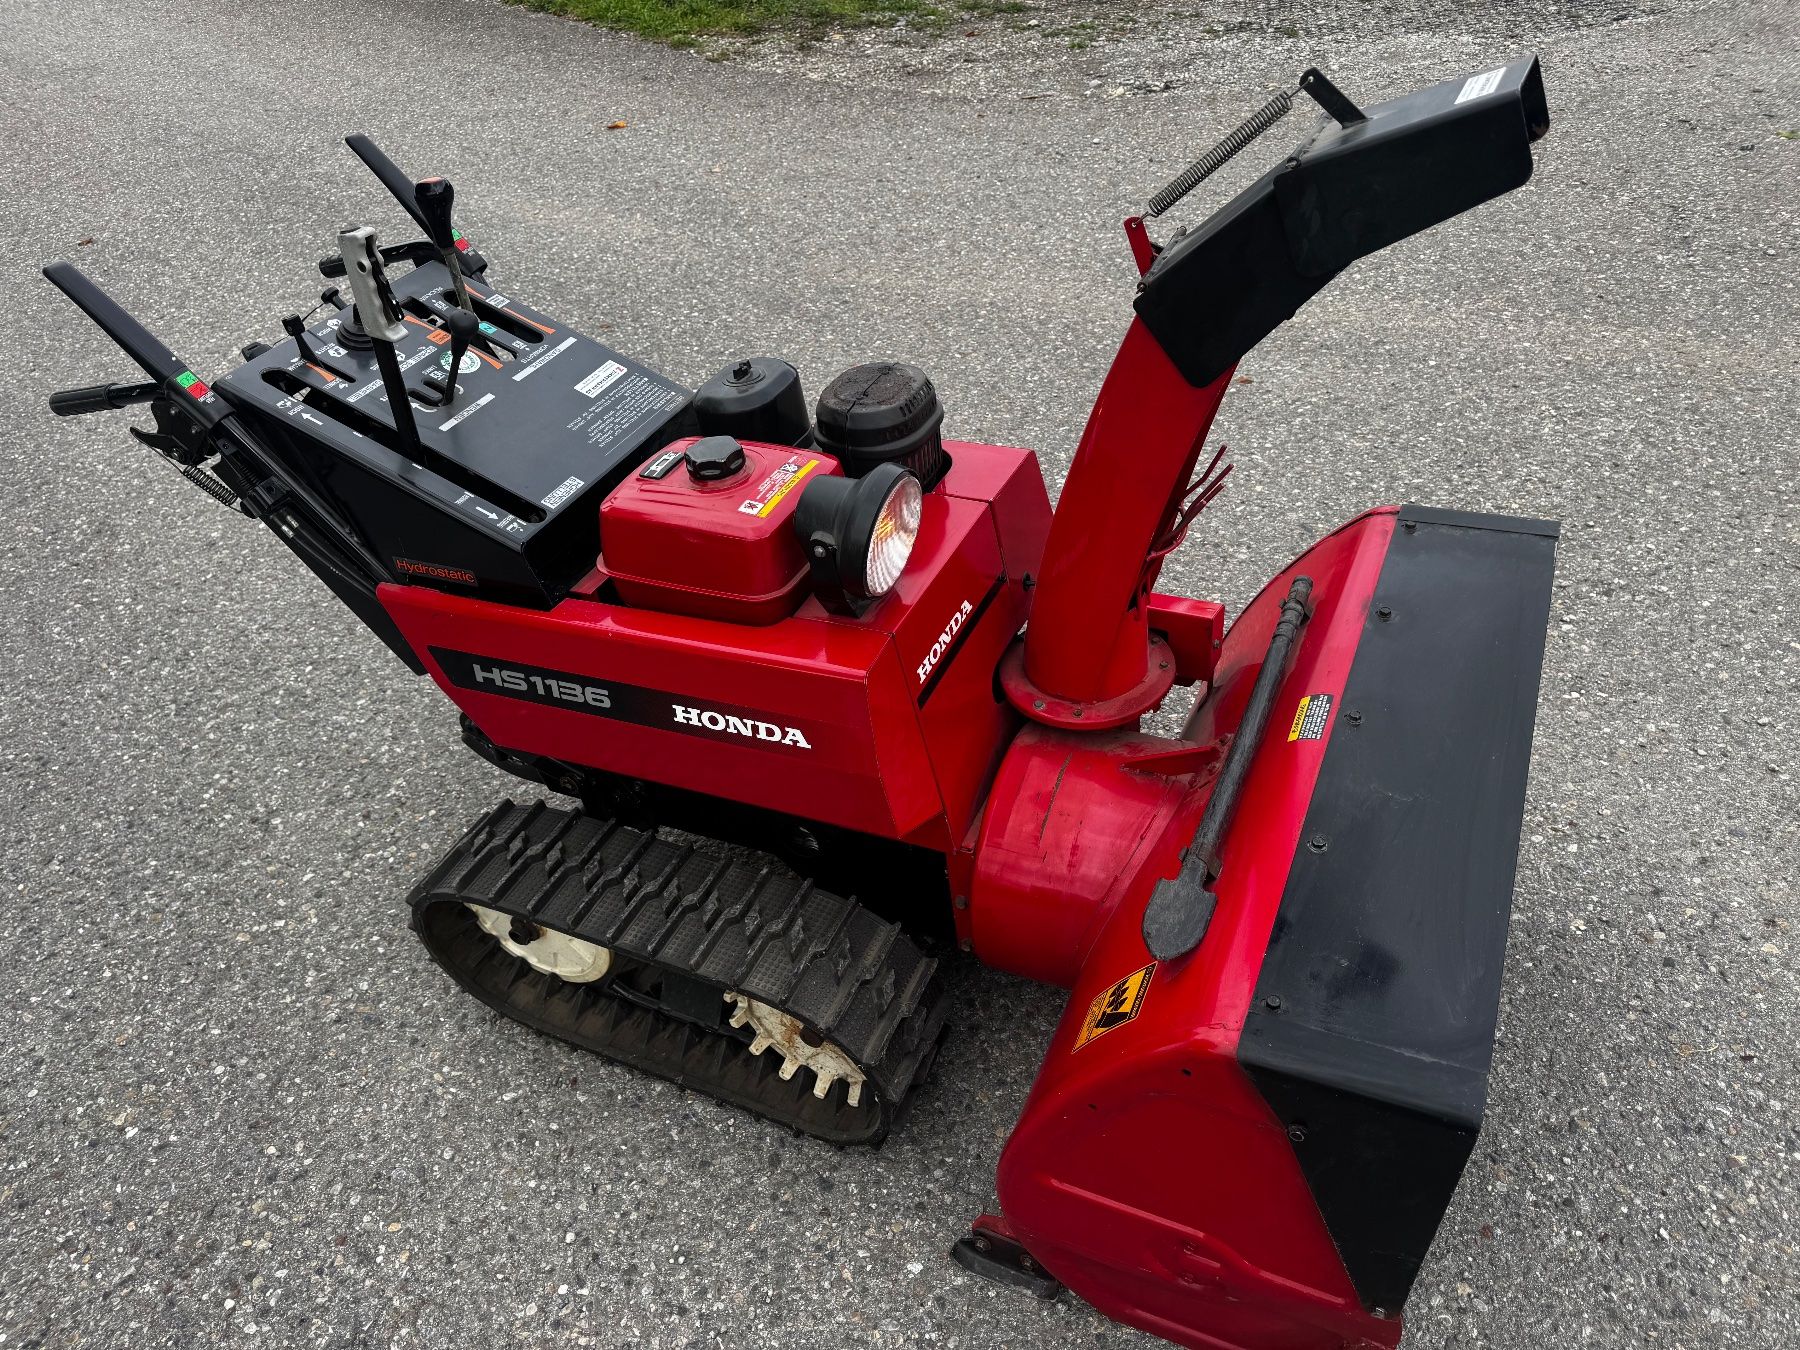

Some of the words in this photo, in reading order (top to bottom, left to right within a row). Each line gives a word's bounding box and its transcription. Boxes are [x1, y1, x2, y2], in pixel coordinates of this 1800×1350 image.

[396, 559, 475, 582] Hydrostatic
[916, 599, 973, 684] HONDA
[472, 663, 611, 709] HS1136
[671, 704, 811, 749] HONDA
